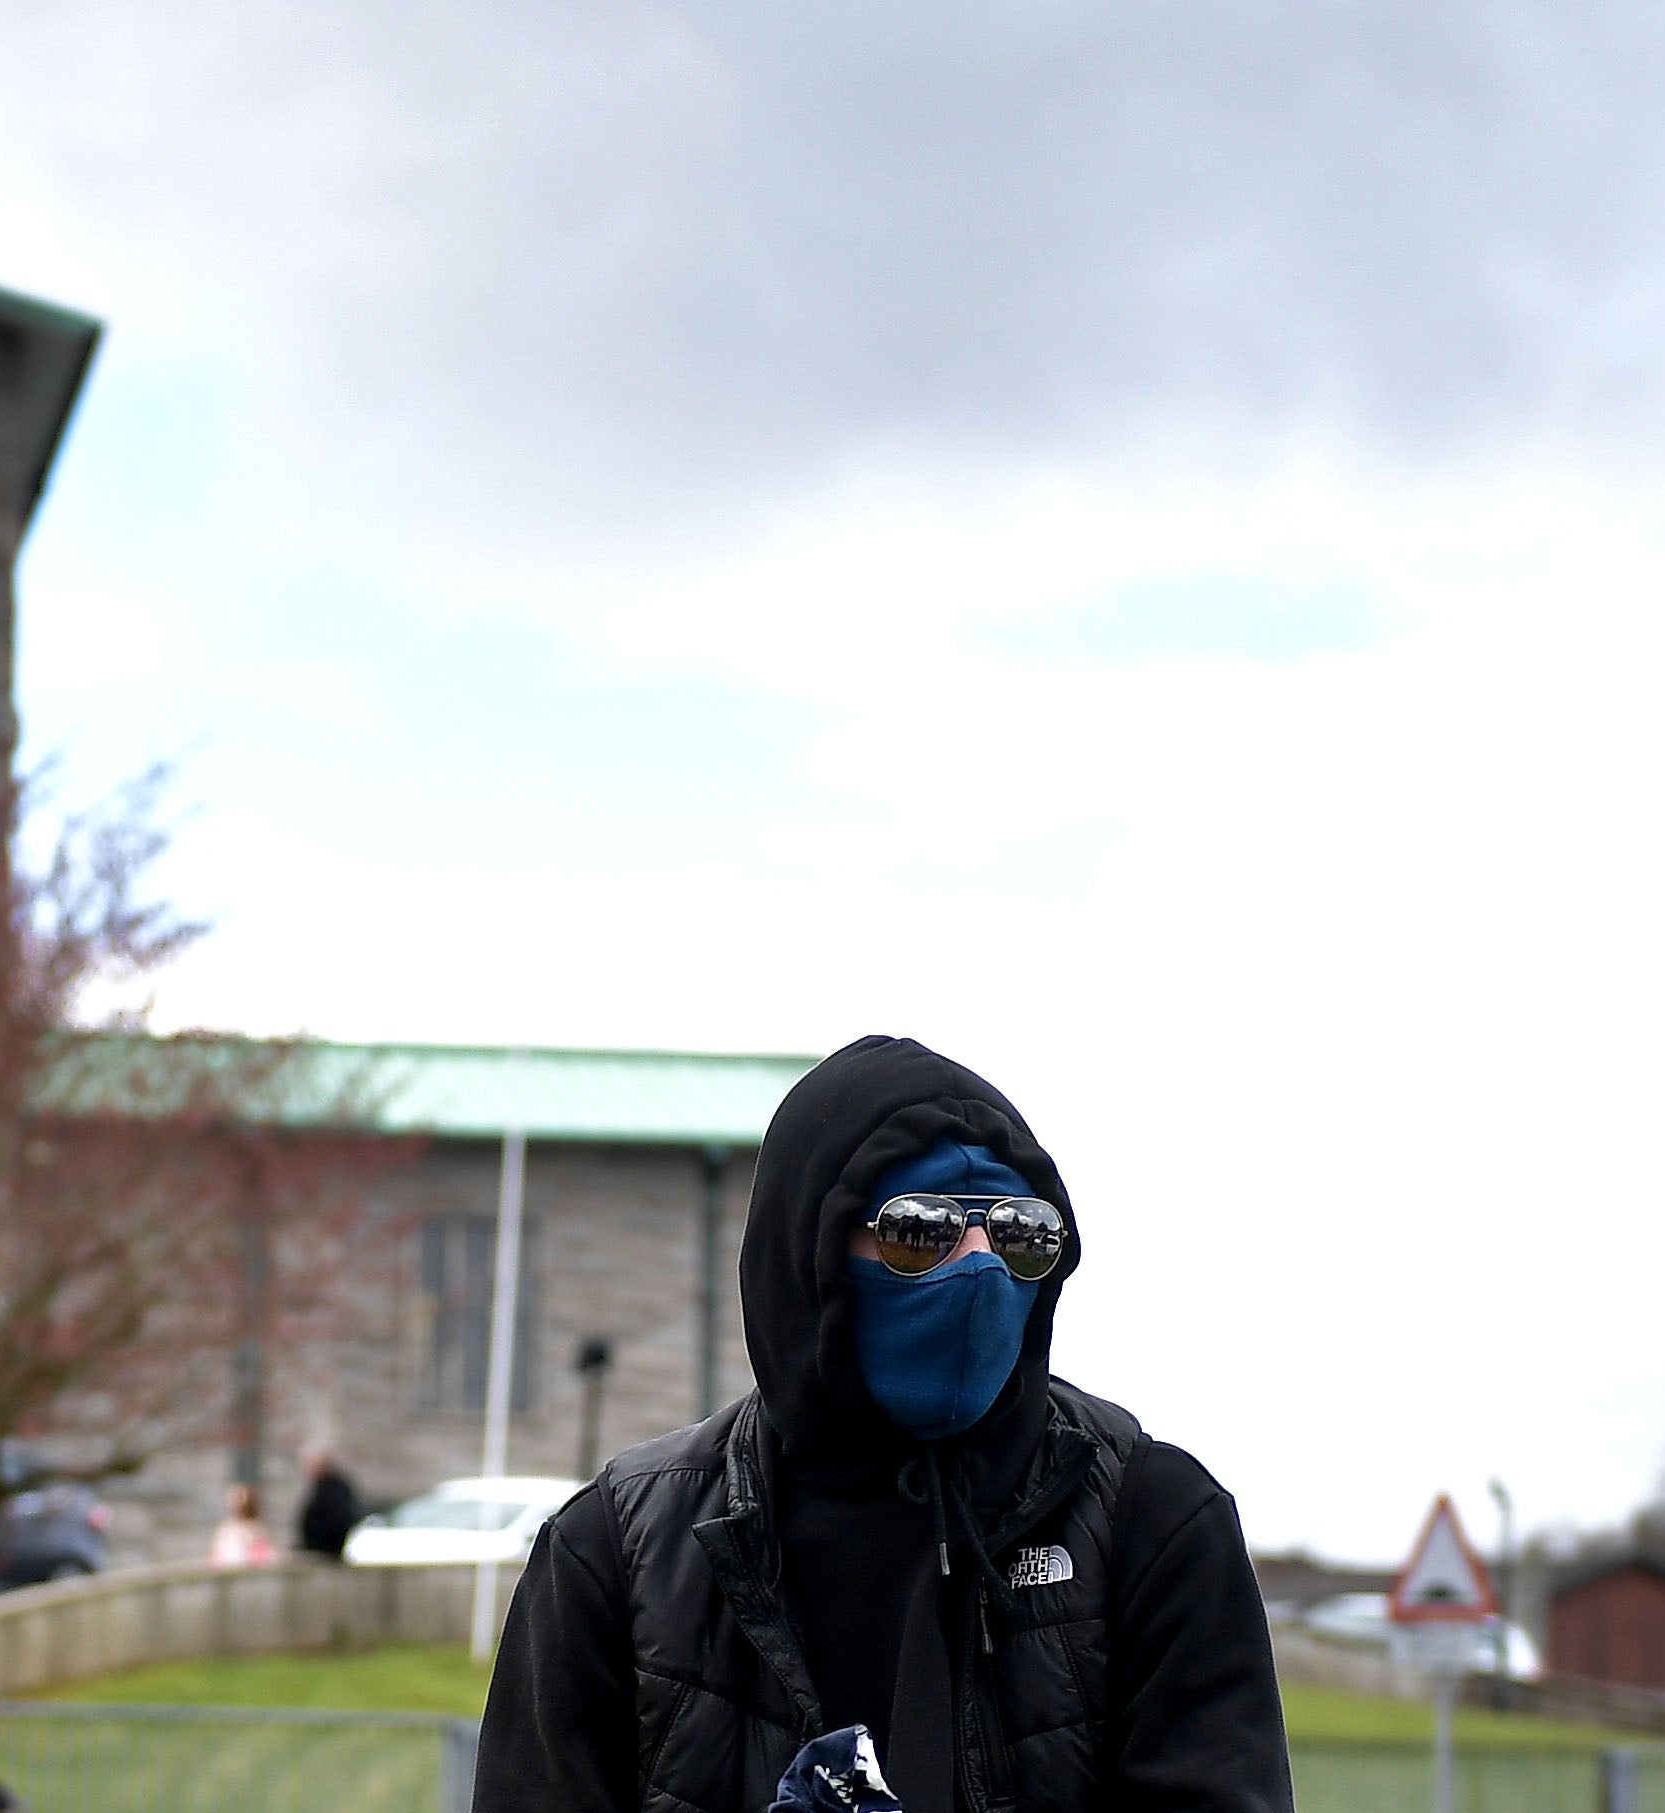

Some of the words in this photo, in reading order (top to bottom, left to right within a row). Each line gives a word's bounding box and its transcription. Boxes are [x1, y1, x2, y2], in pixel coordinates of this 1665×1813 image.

[1018, 1547, 1049, 1560] THE
[1008, 1560, 1048, 1577] ORTH
[1011, 1571, 1047, 1590] FACE
